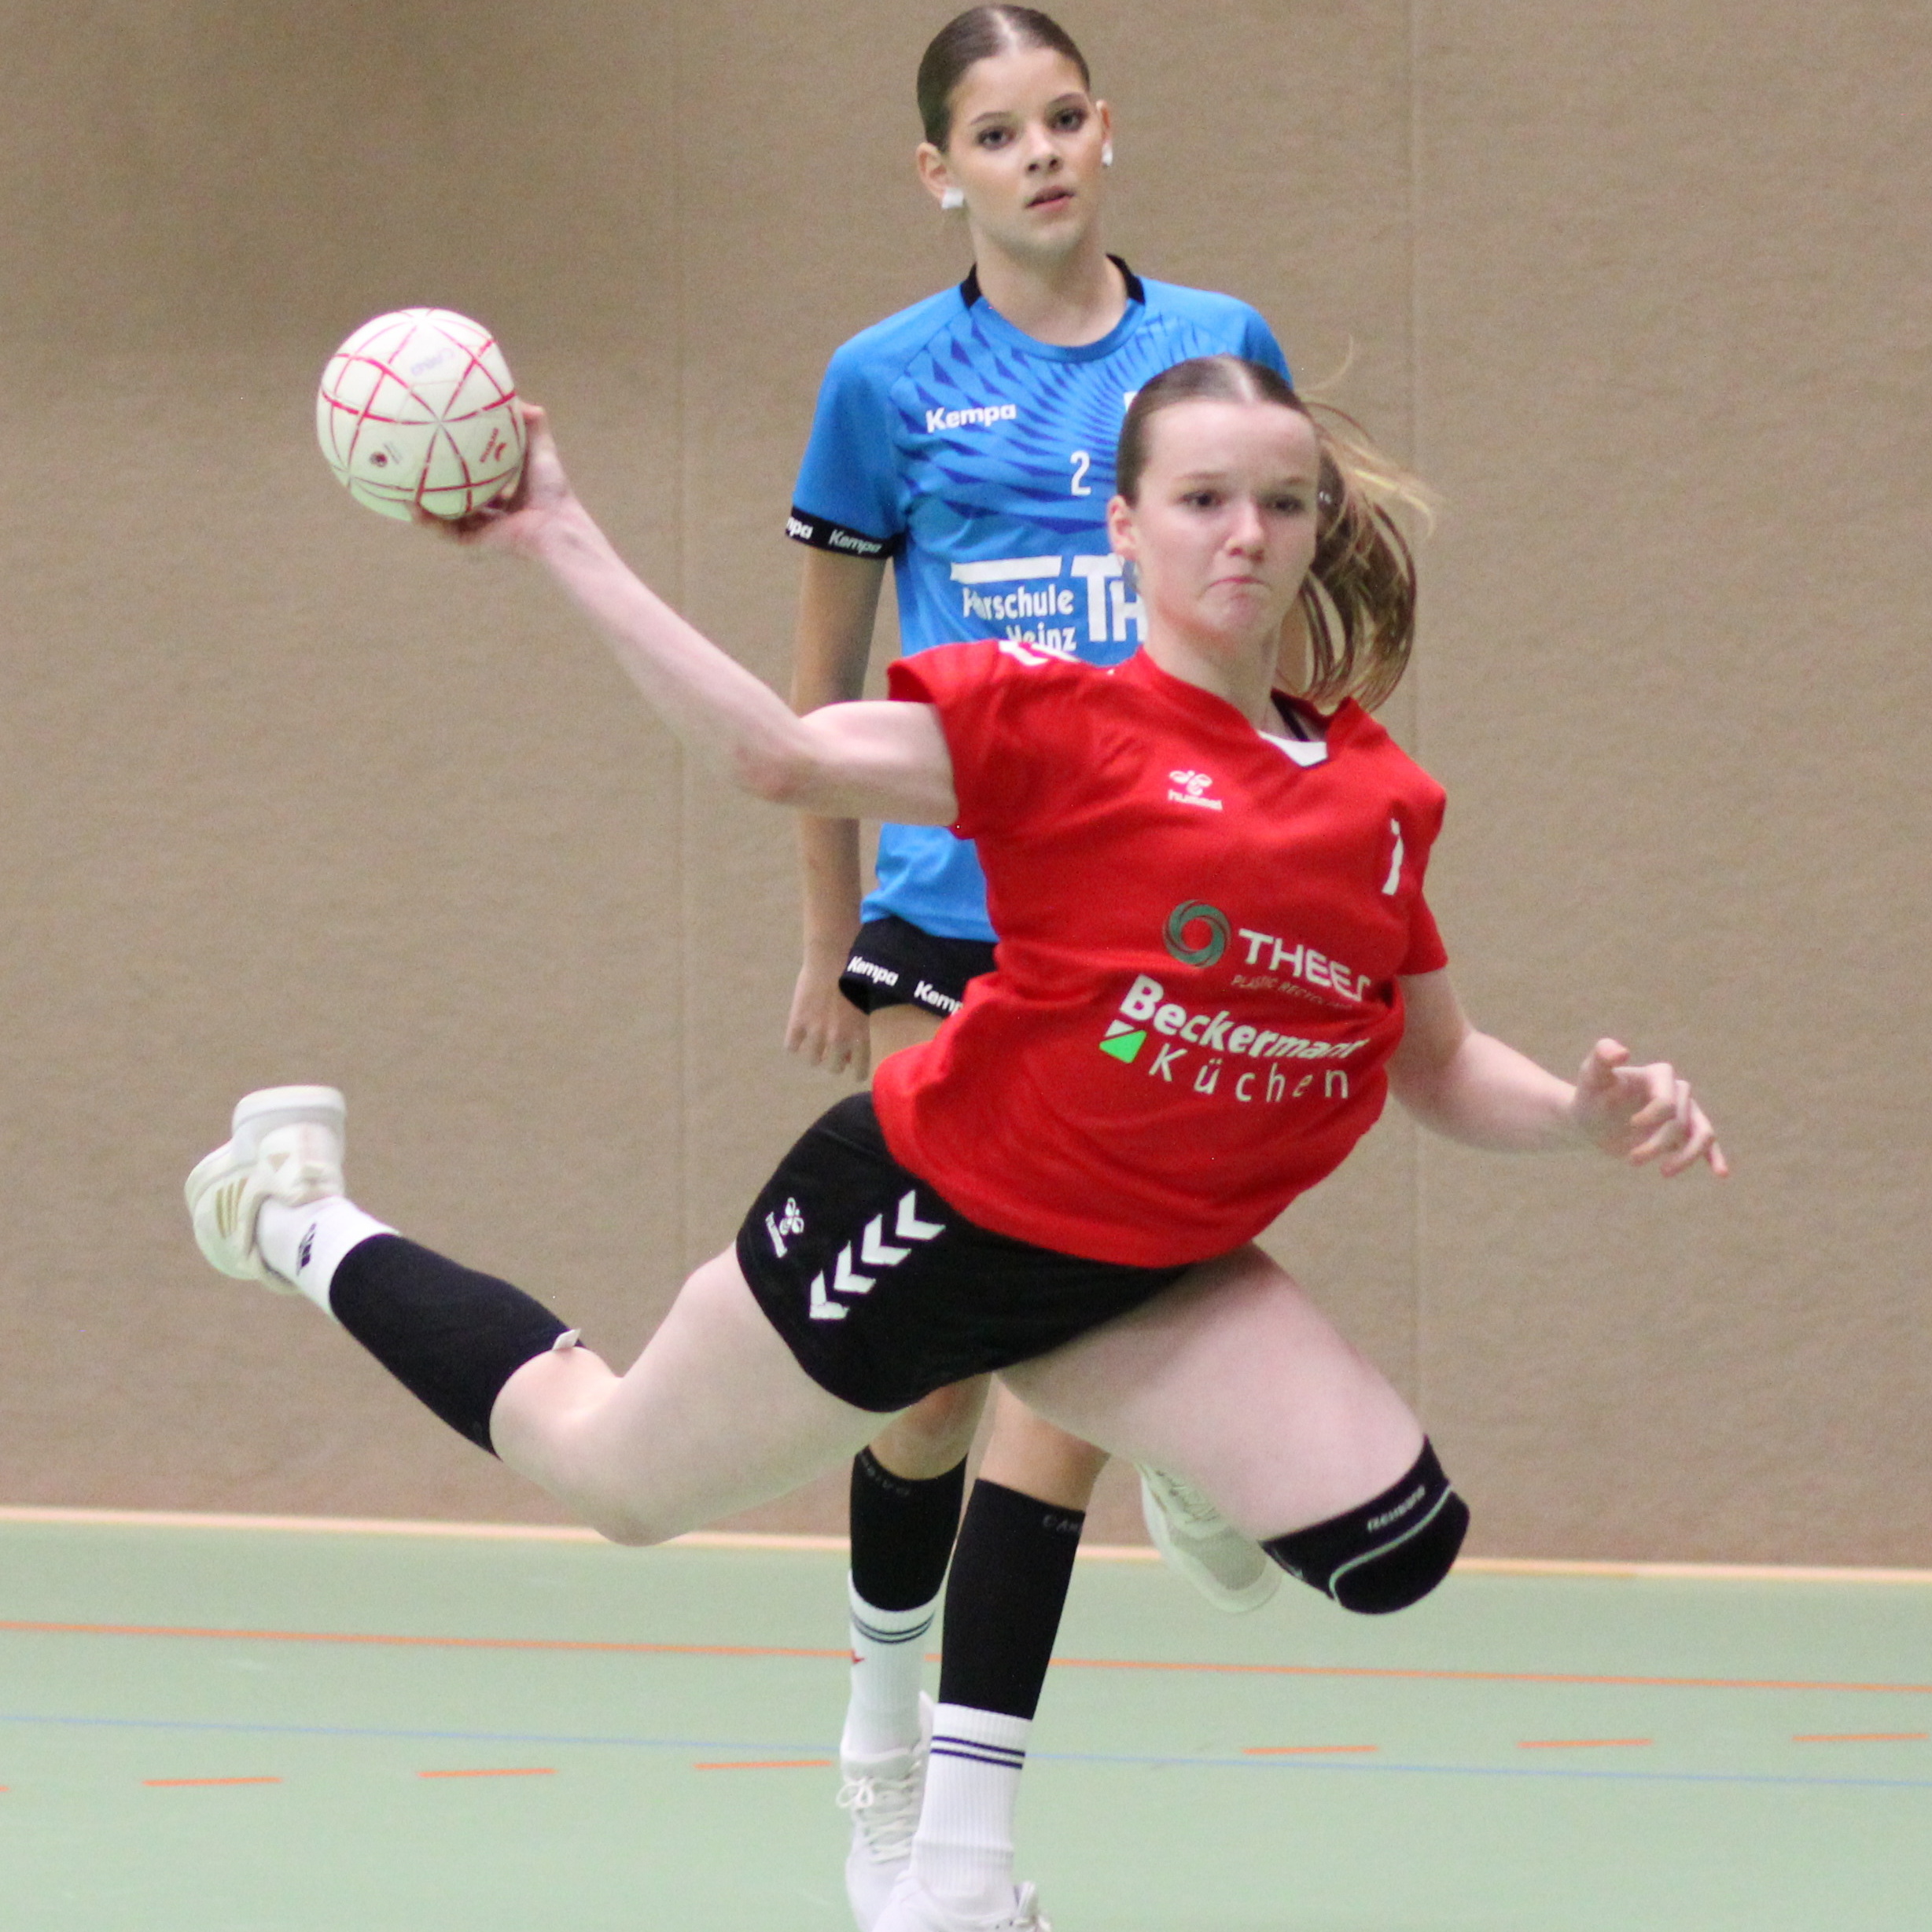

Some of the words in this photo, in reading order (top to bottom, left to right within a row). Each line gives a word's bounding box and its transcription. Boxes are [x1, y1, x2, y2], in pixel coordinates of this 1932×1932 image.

[926, 404, 1018, 433] Kempa
[1069, 451, 1092, 497] 2
[828, 528, 882, 554] Kempa
[847, 955, 900, 987] Kempa
[1147, 1043, 1349, 1103] Küchen
